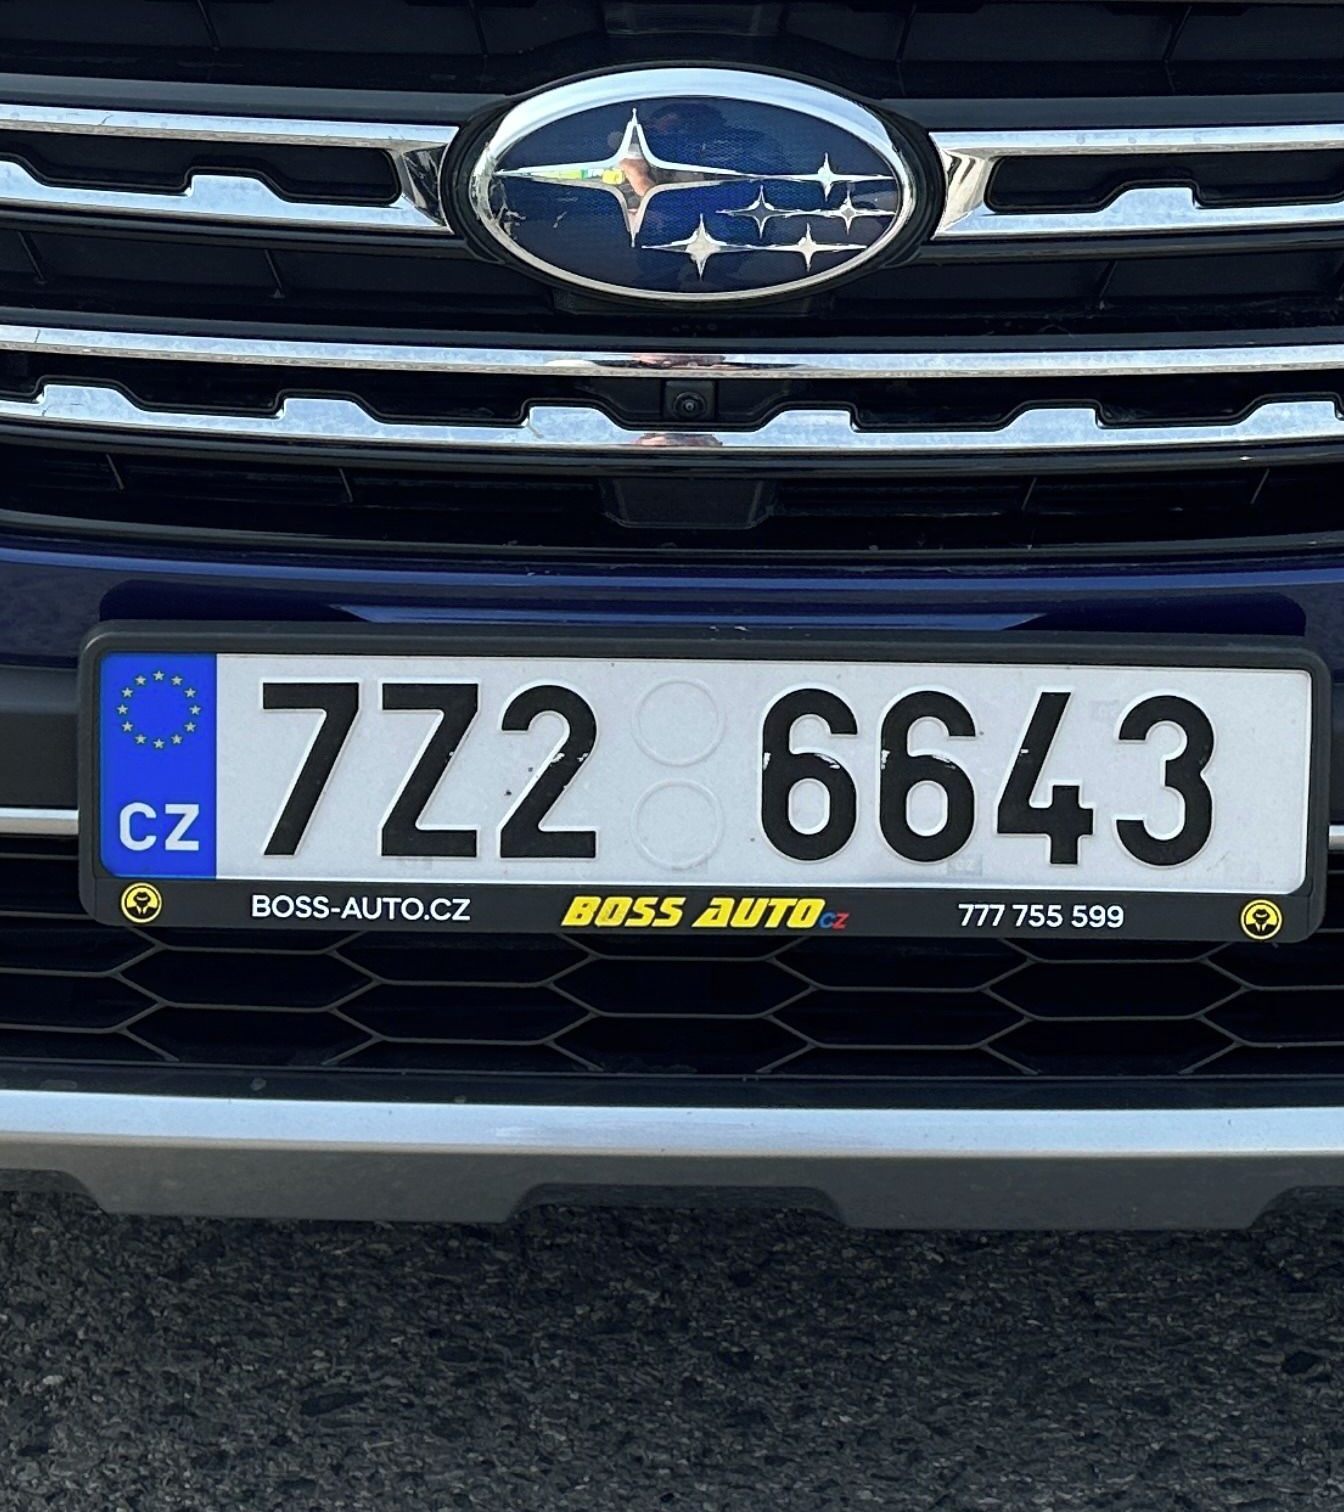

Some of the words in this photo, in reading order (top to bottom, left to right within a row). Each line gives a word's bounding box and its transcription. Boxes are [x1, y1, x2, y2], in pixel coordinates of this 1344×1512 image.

[262, 681, 598, 859] 7Z2
[761, 687, 1215, 866] 6643
[119, 802, 200, 851] CZ
[252, 895, 471, 922] BOSS-AUTO.CZ
[561, 896, 685, 928] BOSS
[691, 897, 826, 929] AUTO
[958, 902, 1005, 928] 777
[1013, 903, 1063, 928] 755
[1071, 904, 1125, 930] 599
